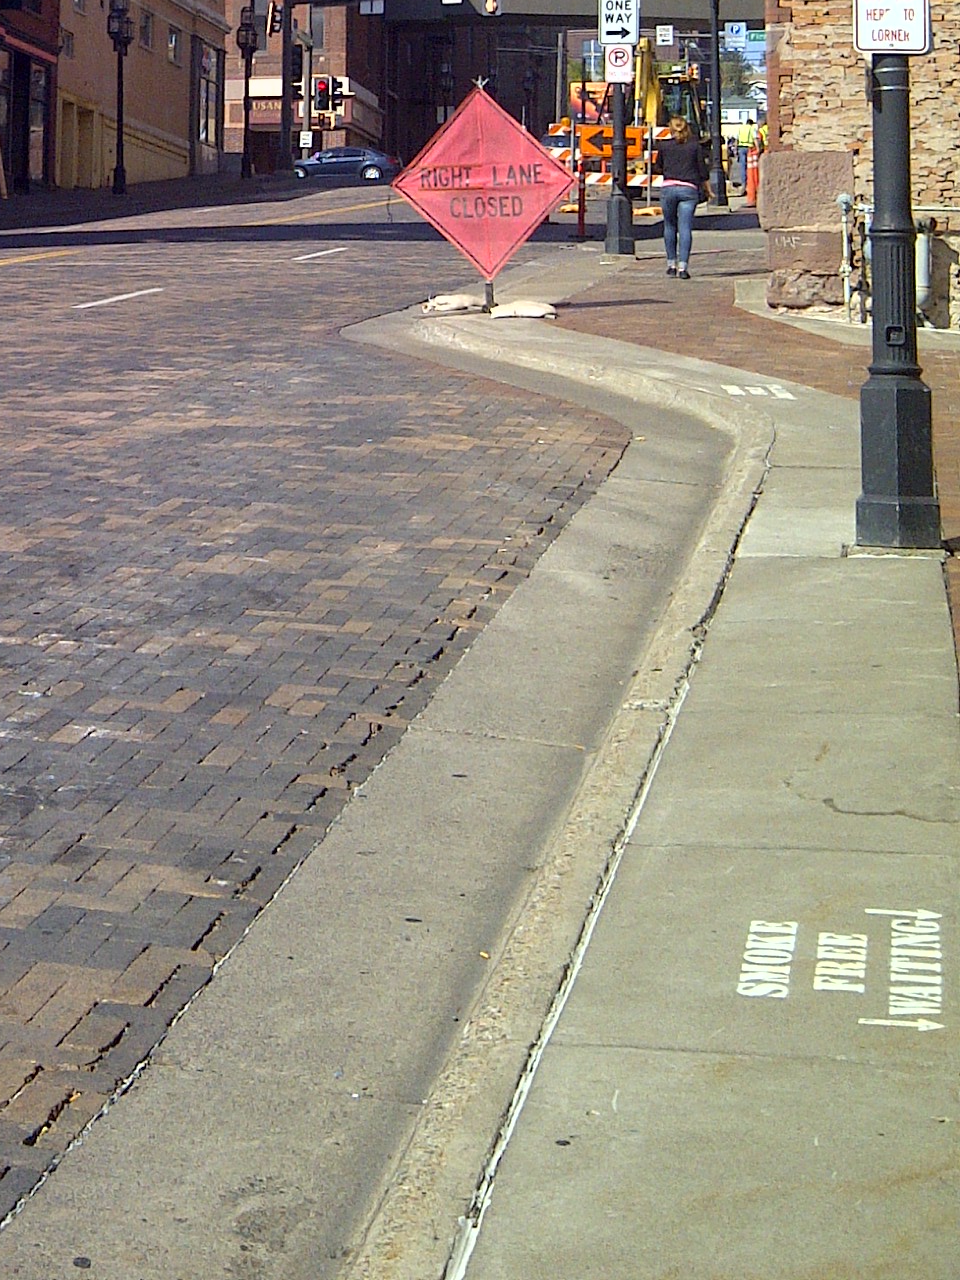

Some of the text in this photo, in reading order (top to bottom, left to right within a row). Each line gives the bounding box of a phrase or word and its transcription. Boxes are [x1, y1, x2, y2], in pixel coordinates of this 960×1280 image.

[605, 0, 632, 11] ONE
[904, 8, 915, 21] TO
[605, 13, 633, 24] WAY
[421, 163, 545, 188] RIGHT LANE
[450, 196, 523, 218] CLOSED
[736, 920, 798, 998] SMOKE
[813, 932, 868, 993] FREE
[889, 919, 943, 1015] WAITING
